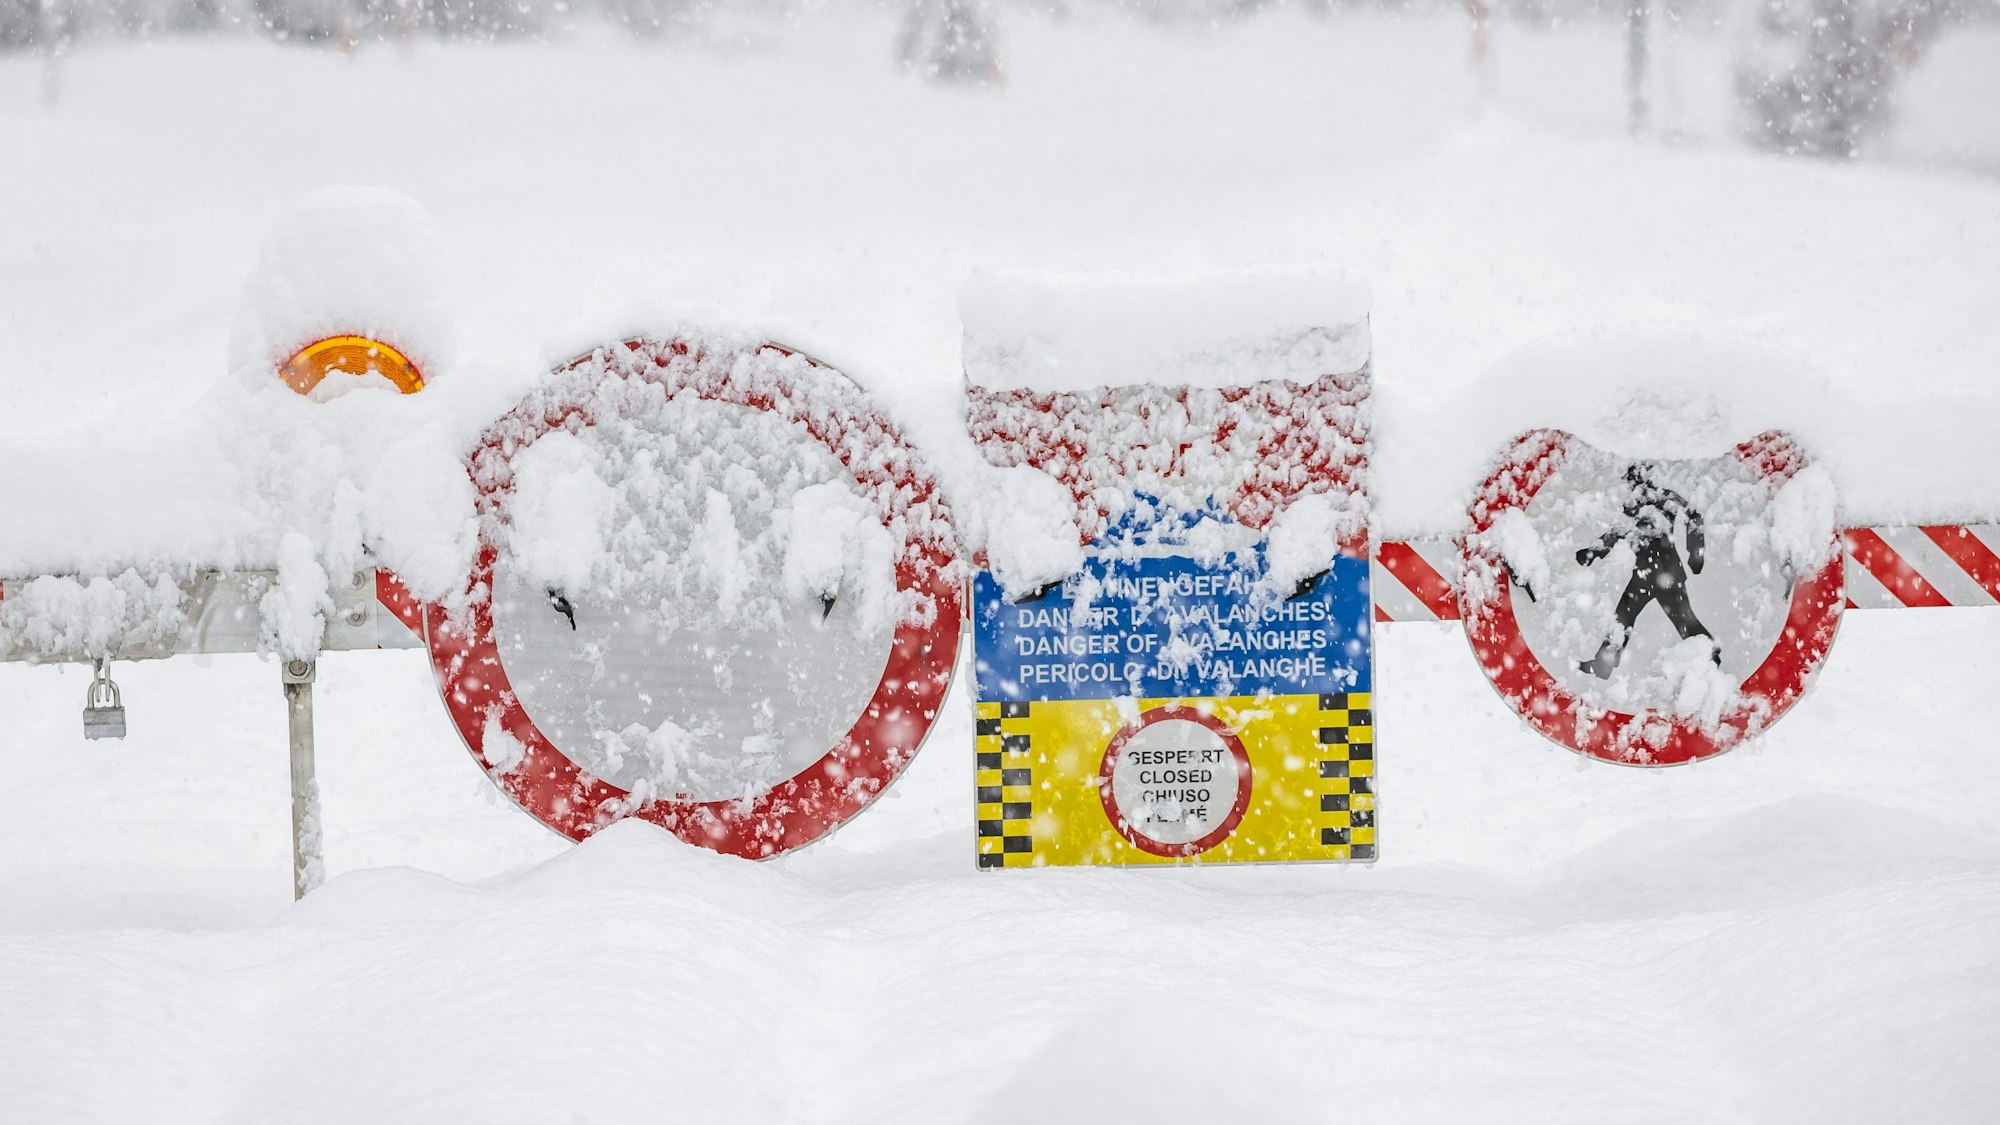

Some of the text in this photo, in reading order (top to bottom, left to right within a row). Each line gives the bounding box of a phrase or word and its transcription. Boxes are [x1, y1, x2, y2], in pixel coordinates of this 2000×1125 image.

[1062, 573, 1262, 600] LWINENGEFAH
[1019, 606, 1119, 629] DANR
[1163, 602, 1326, 625] AVALANCHES
[1019, 634, 1120, 656] DANGER
[1126, 633, 1158, 653] OF
[1020, 661, 1141, 684] PERICOLO
[1196, 656, 1326, 679] VALANGHE
[1139, 769, 1212, 785] CLOSED
[1142, 788, 1210, 803] CHIUSO
